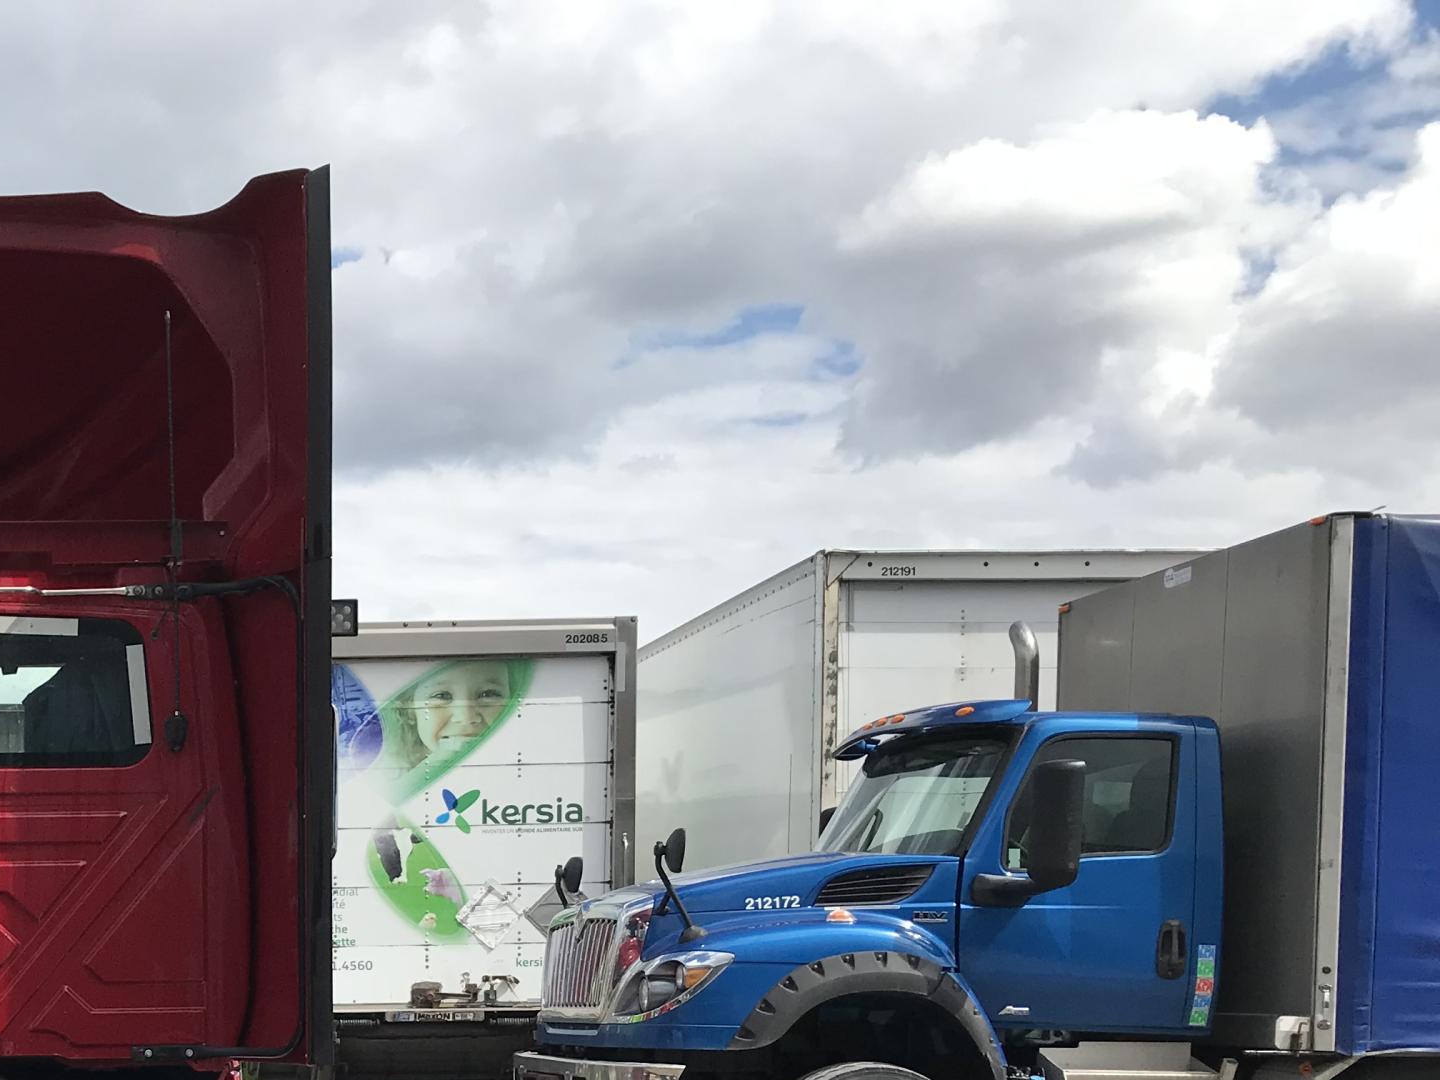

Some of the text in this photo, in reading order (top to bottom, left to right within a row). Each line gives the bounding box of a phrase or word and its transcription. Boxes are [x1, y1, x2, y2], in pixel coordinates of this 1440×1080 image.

[881, 566, 916, 576] 212191
[565, 633, 608, 644] 202085
[482, 797, 583, 825] kersia
[744, 895, 801, 910] 212172
[515, 957, 543, 967] kersi
